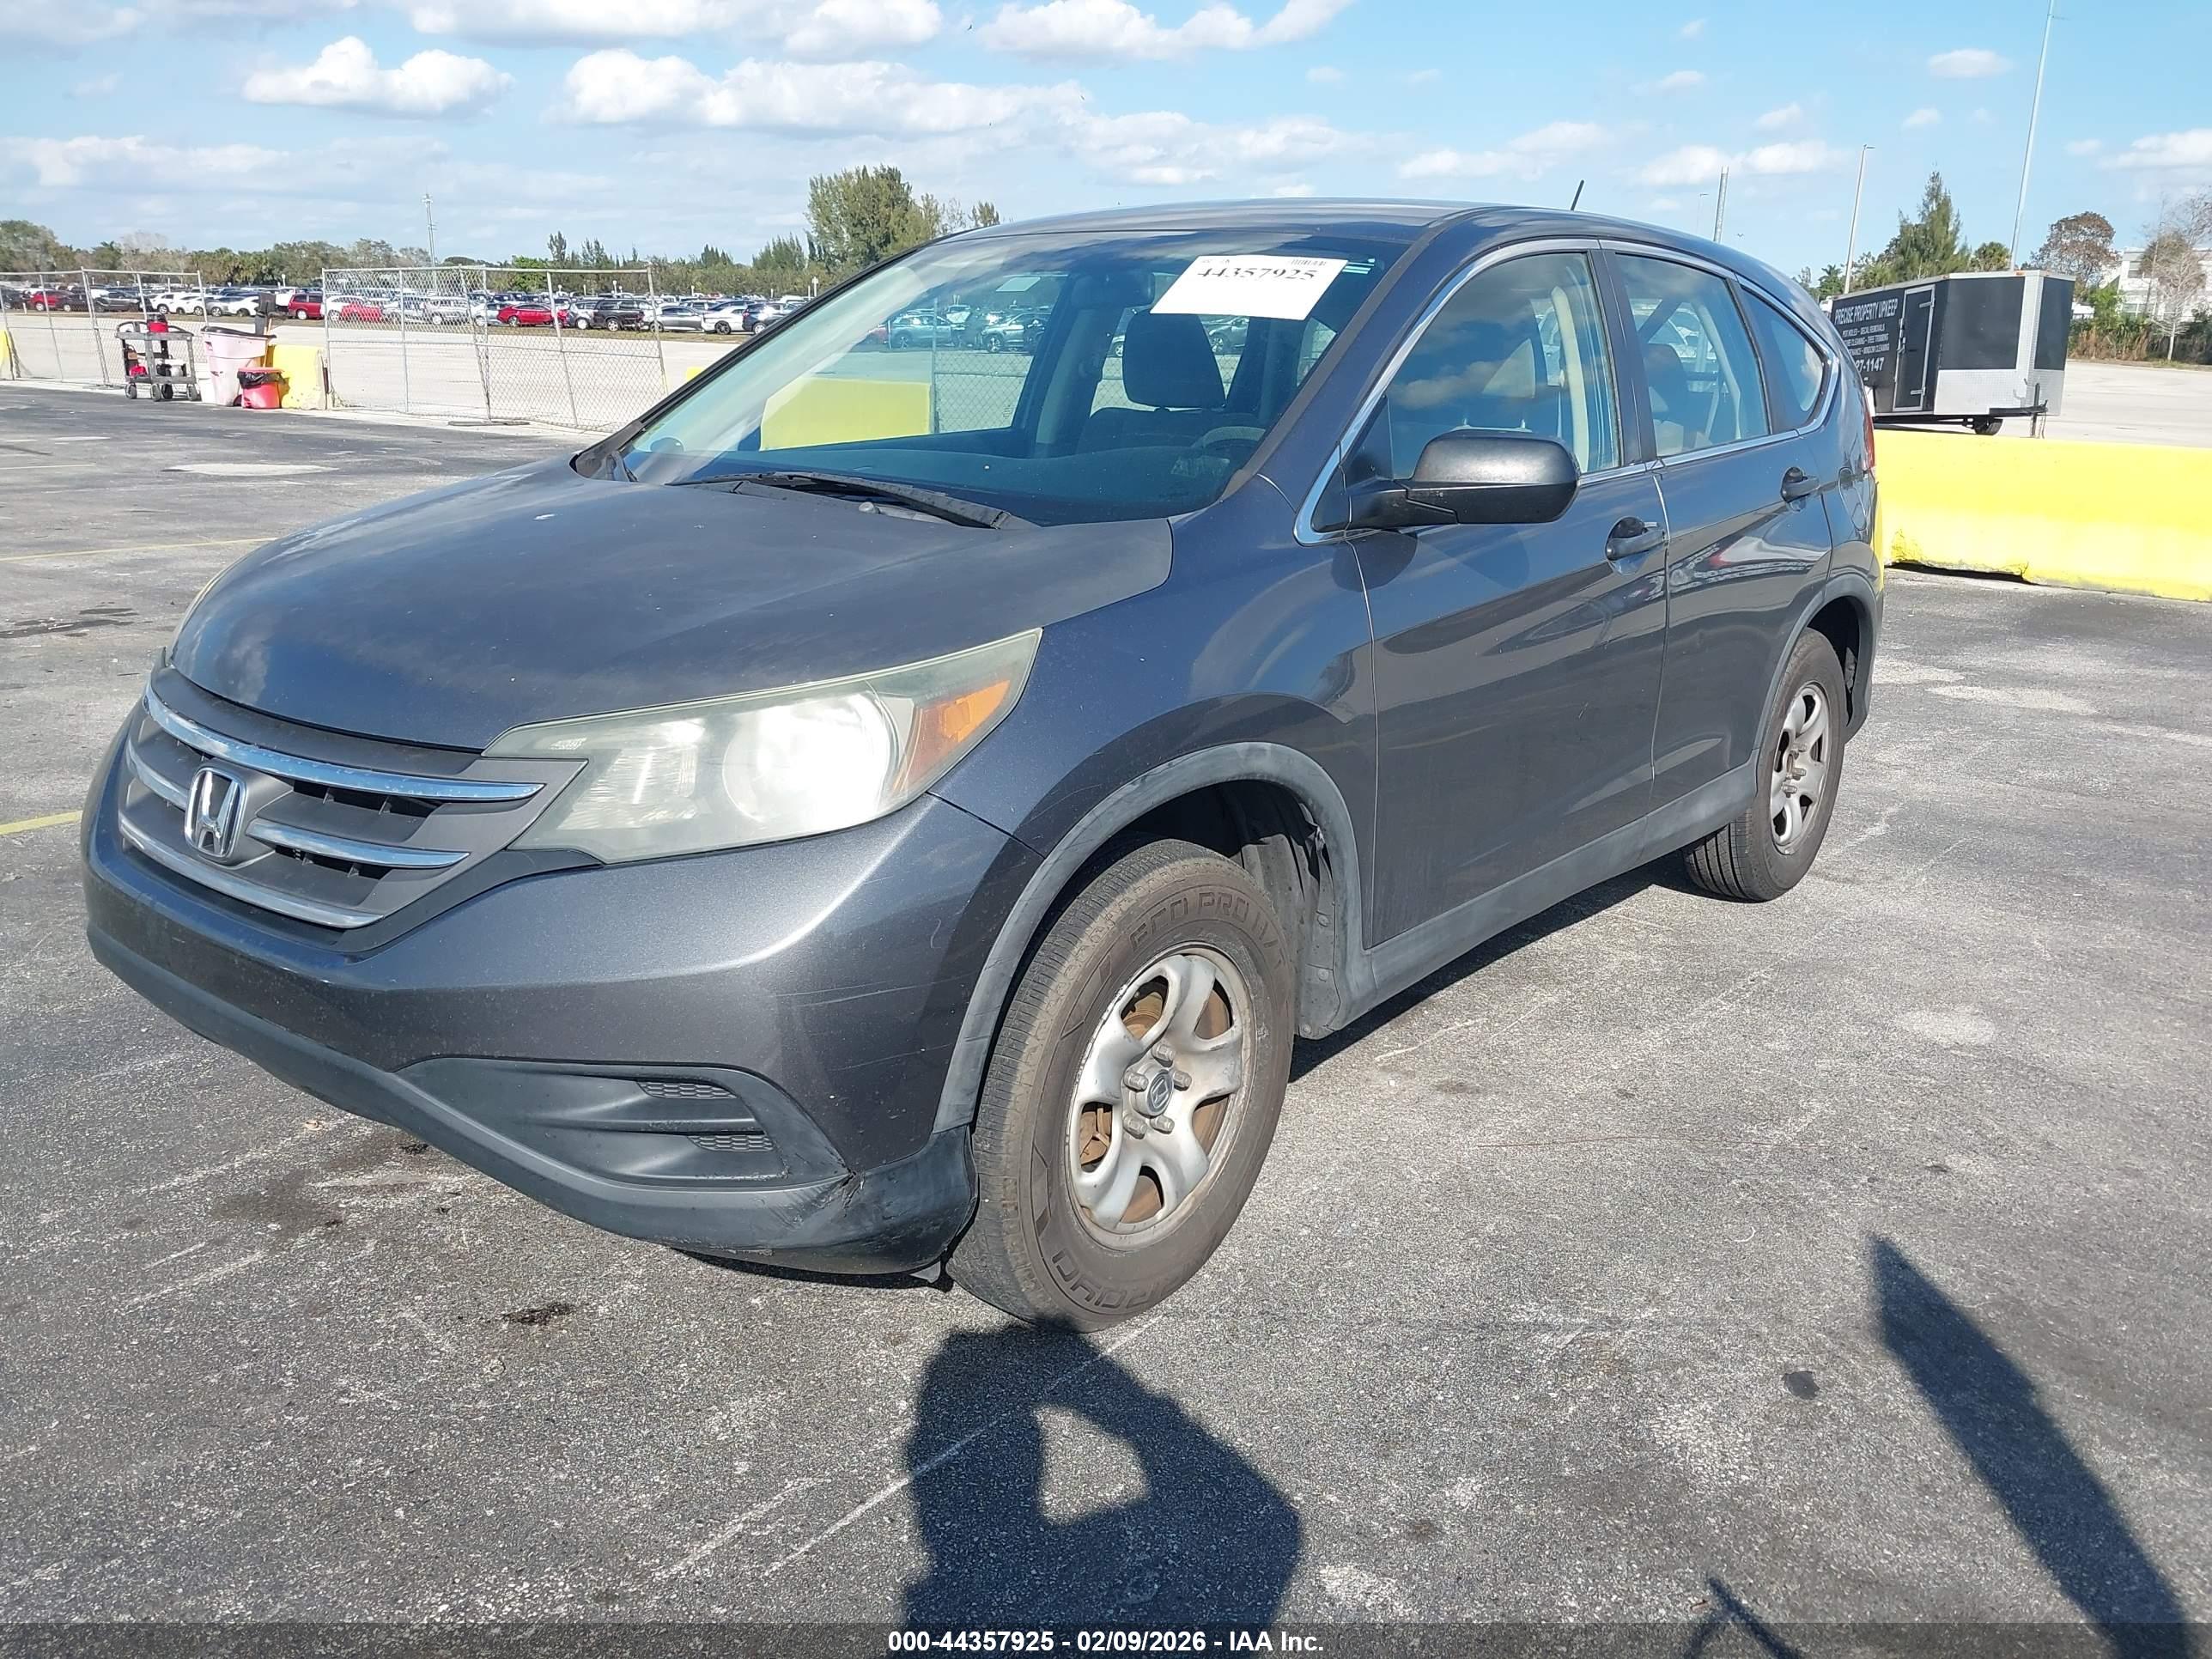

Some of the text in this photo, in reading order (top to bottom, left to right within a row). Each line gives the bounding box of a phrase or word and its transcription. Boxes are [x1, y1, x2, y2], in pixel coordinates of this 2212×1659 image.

[1197, 267, 1319, 280] 44357925
[1834, 298, 1899, 325] PRECISE PROPERTY UPKEEP
